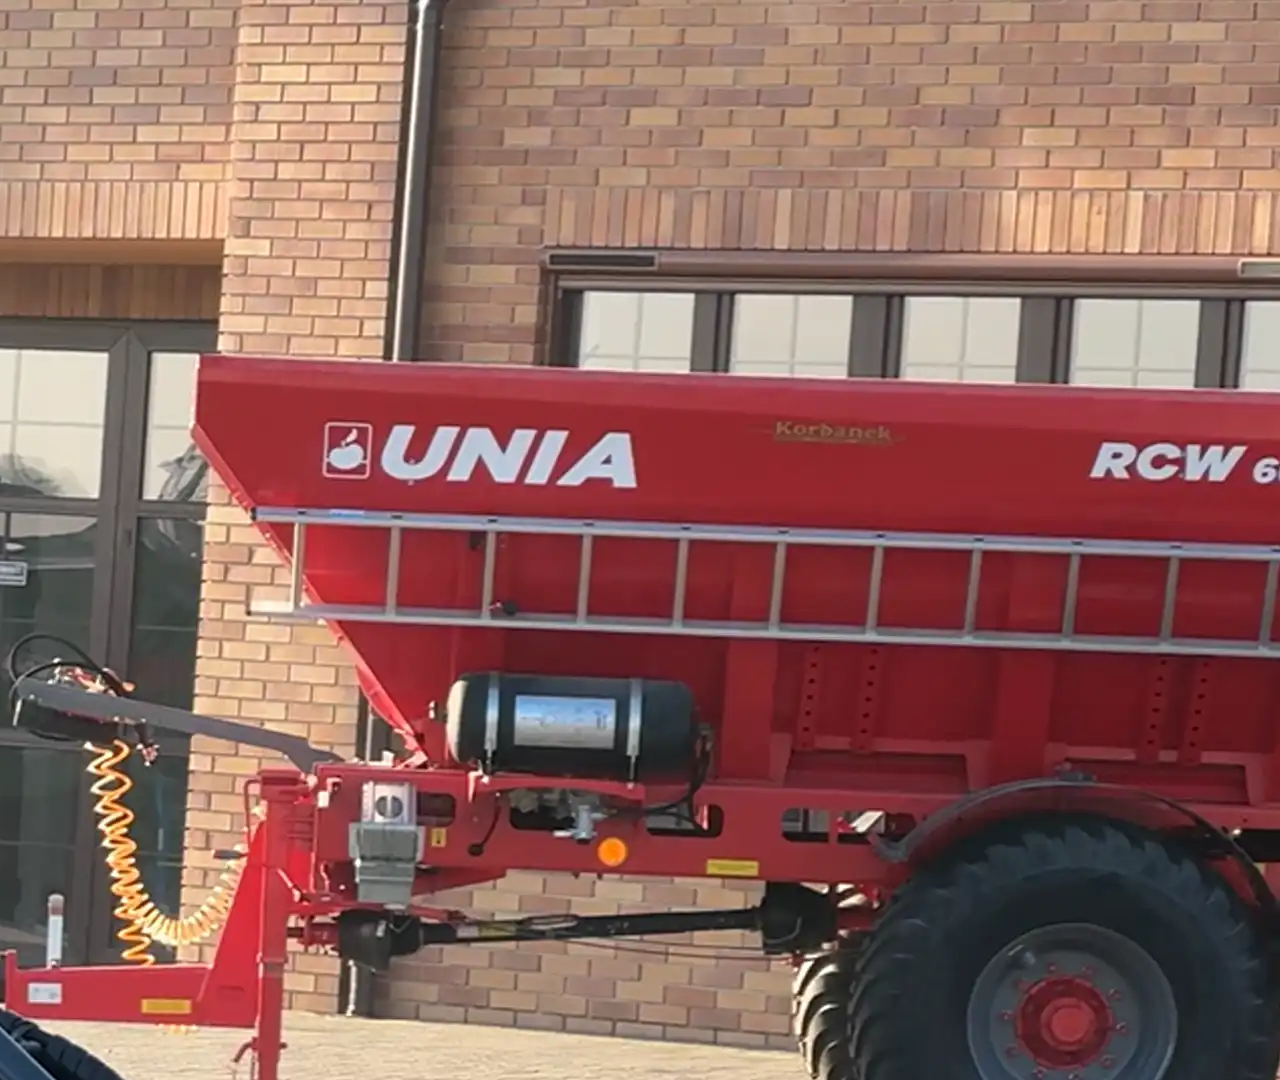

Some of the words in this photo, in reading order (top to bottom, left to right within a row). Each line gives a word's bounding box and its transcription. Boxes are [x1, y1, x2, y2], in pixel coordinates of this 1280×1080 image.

[380, 424, 637, 488] UNIA
[1089, 442, 1248, 482] RCW
[1252, 457, 1280, 484] 6
